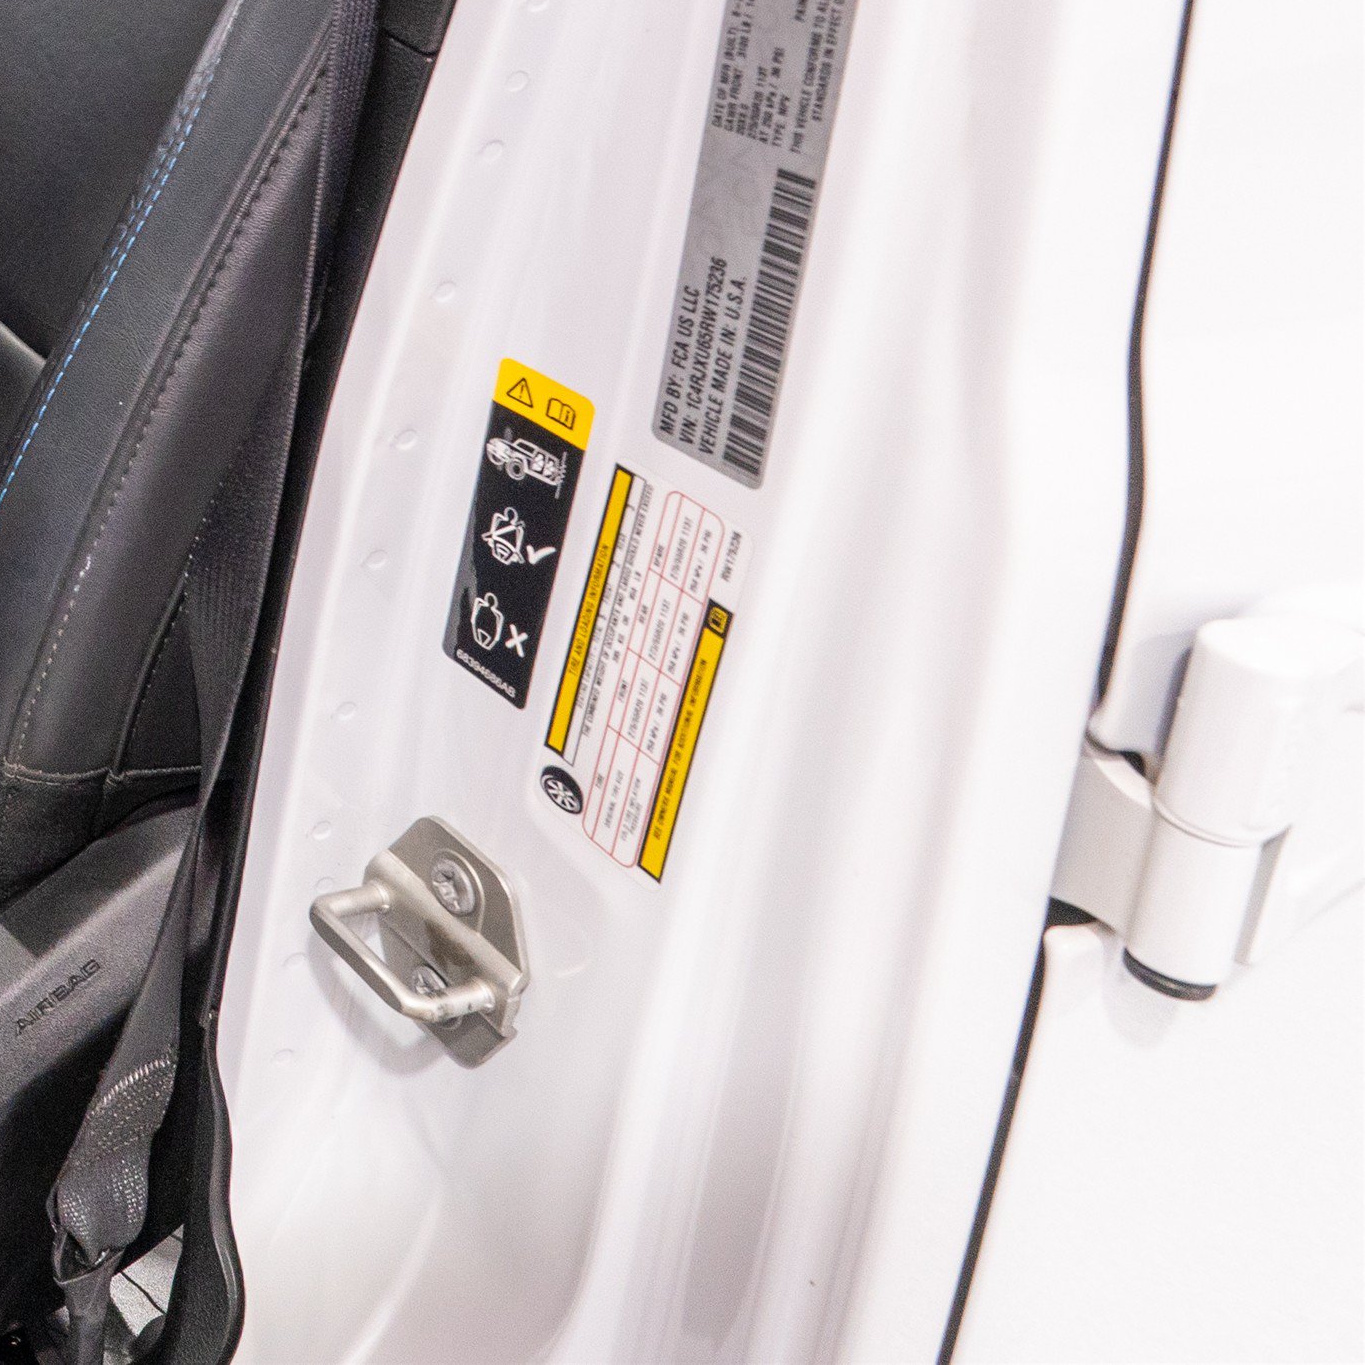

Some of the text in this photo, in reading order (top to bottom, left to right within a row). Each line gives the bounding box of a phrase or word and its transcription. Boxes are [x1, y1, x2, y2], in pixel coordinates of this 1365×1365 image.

[680, 283, 700, 315] LLC
[675, 313, 694, 339] US
[670, 337, 690, 370] FCA
[709, 346, 733, 394] MADE
[658, 398, 678, 436] MFD
[697, 392, 724, 458] VEHICLE
[17, 958, 102, 1035] AIRBAG
